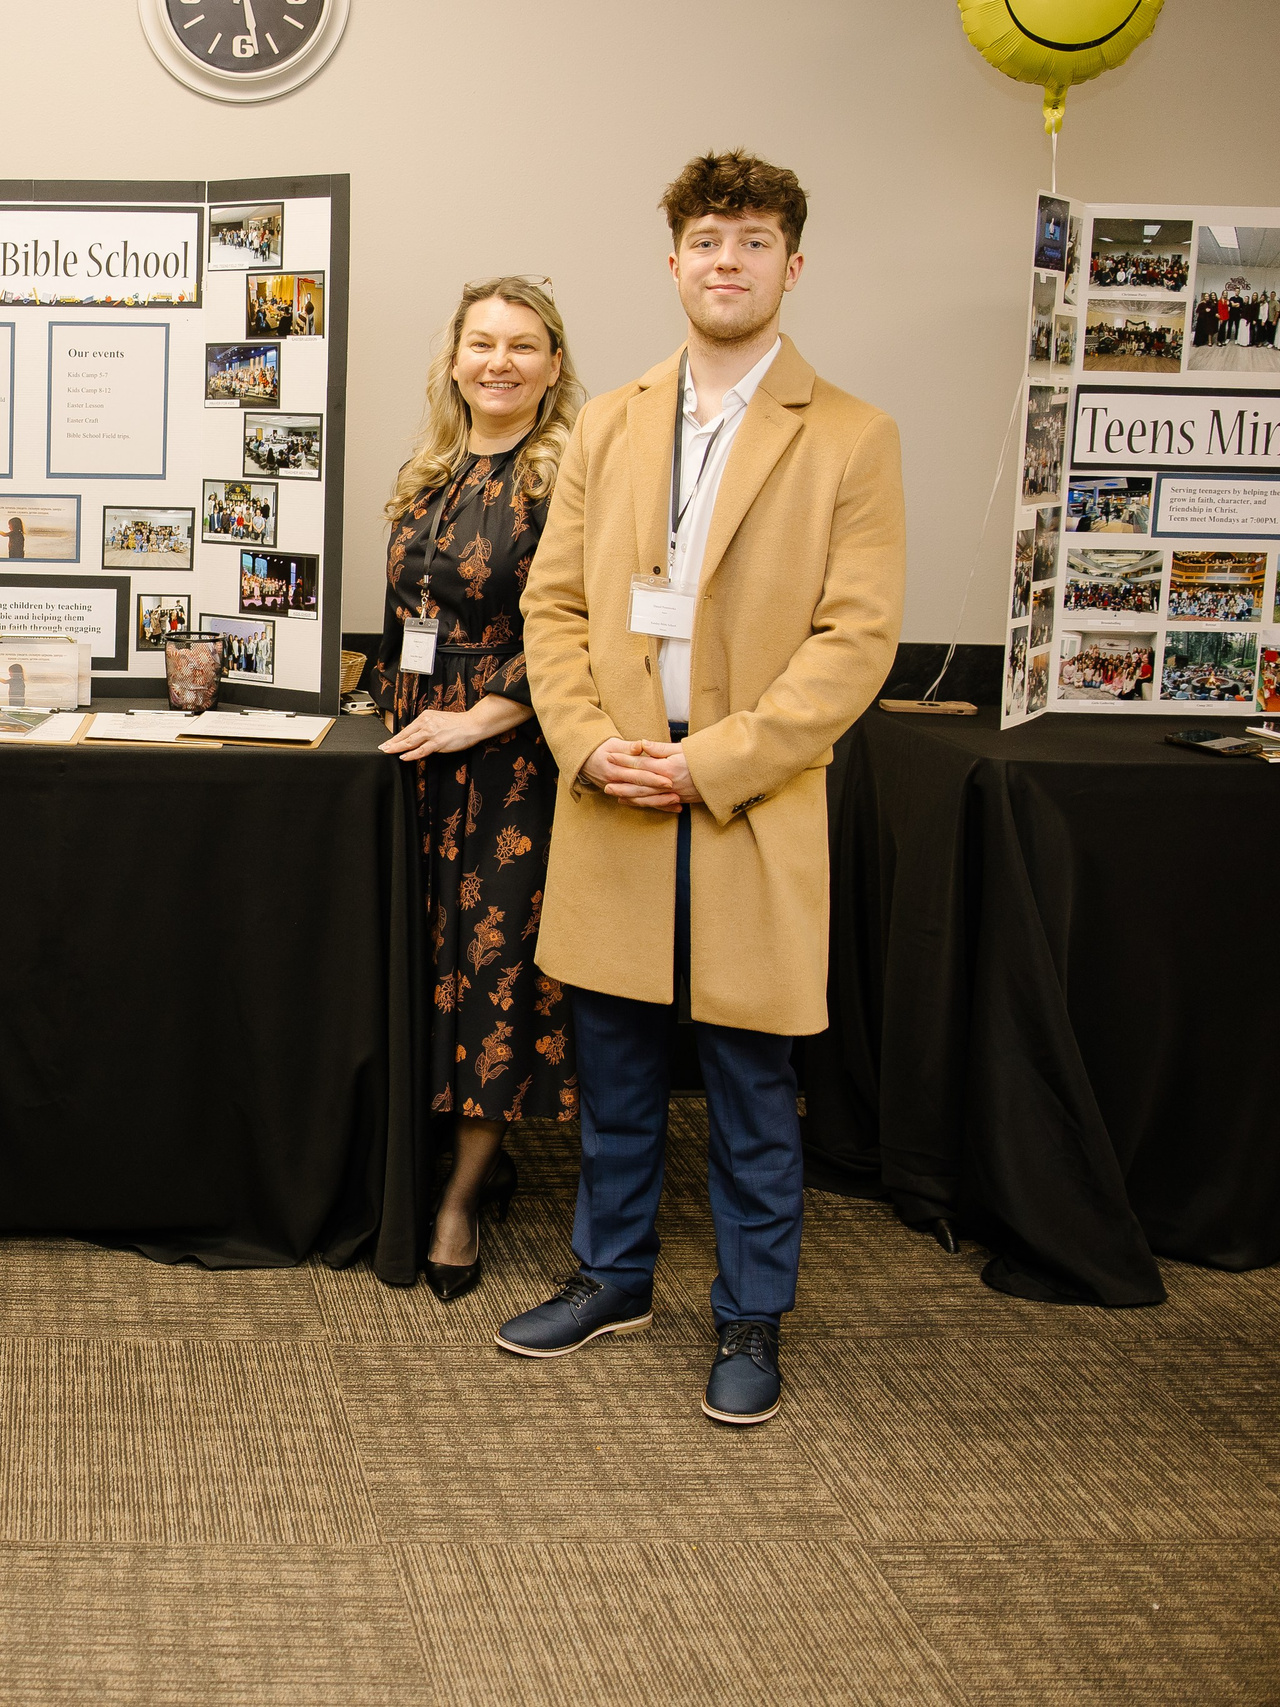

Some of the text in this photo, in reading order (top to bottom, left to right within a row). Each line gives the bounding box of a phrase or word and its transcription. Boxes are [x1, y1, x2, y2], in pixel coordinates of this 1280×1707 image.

[0, 239, 79, 279] Bible
[86, 240, 190, 279] School
[68, 348, 125, 358] Our events
[1081, 407, 1280, 456] Teens Min
[1170, 486, 1197, 495] Serving
[1198, 487, 1231, 495] teenagers
[1232, 488, 1241, 496] by
[1242, 488, 1268, 497] helping
[1197, 496, 1216, 504] faith,
[1217, 497, 1252, 505] character,
[1169, 505, 1204, 514] friendship
[1214, 506, 1238, 514] Christ.
[1168, 514, 1188, 522] Teens
[1208, 515, 1240, 524] Mondays
[9, 601, 43, 610] children
[45, 602, 56, 612] by
[58, 602, 92, 612] teaching
[14, 612, 30, 620] and
[32, 613, 62, 622] helping
[9, 623, 28, 631] faith
[30, 624, 63, 633] through
[64, 625, 102, 634] engaging
